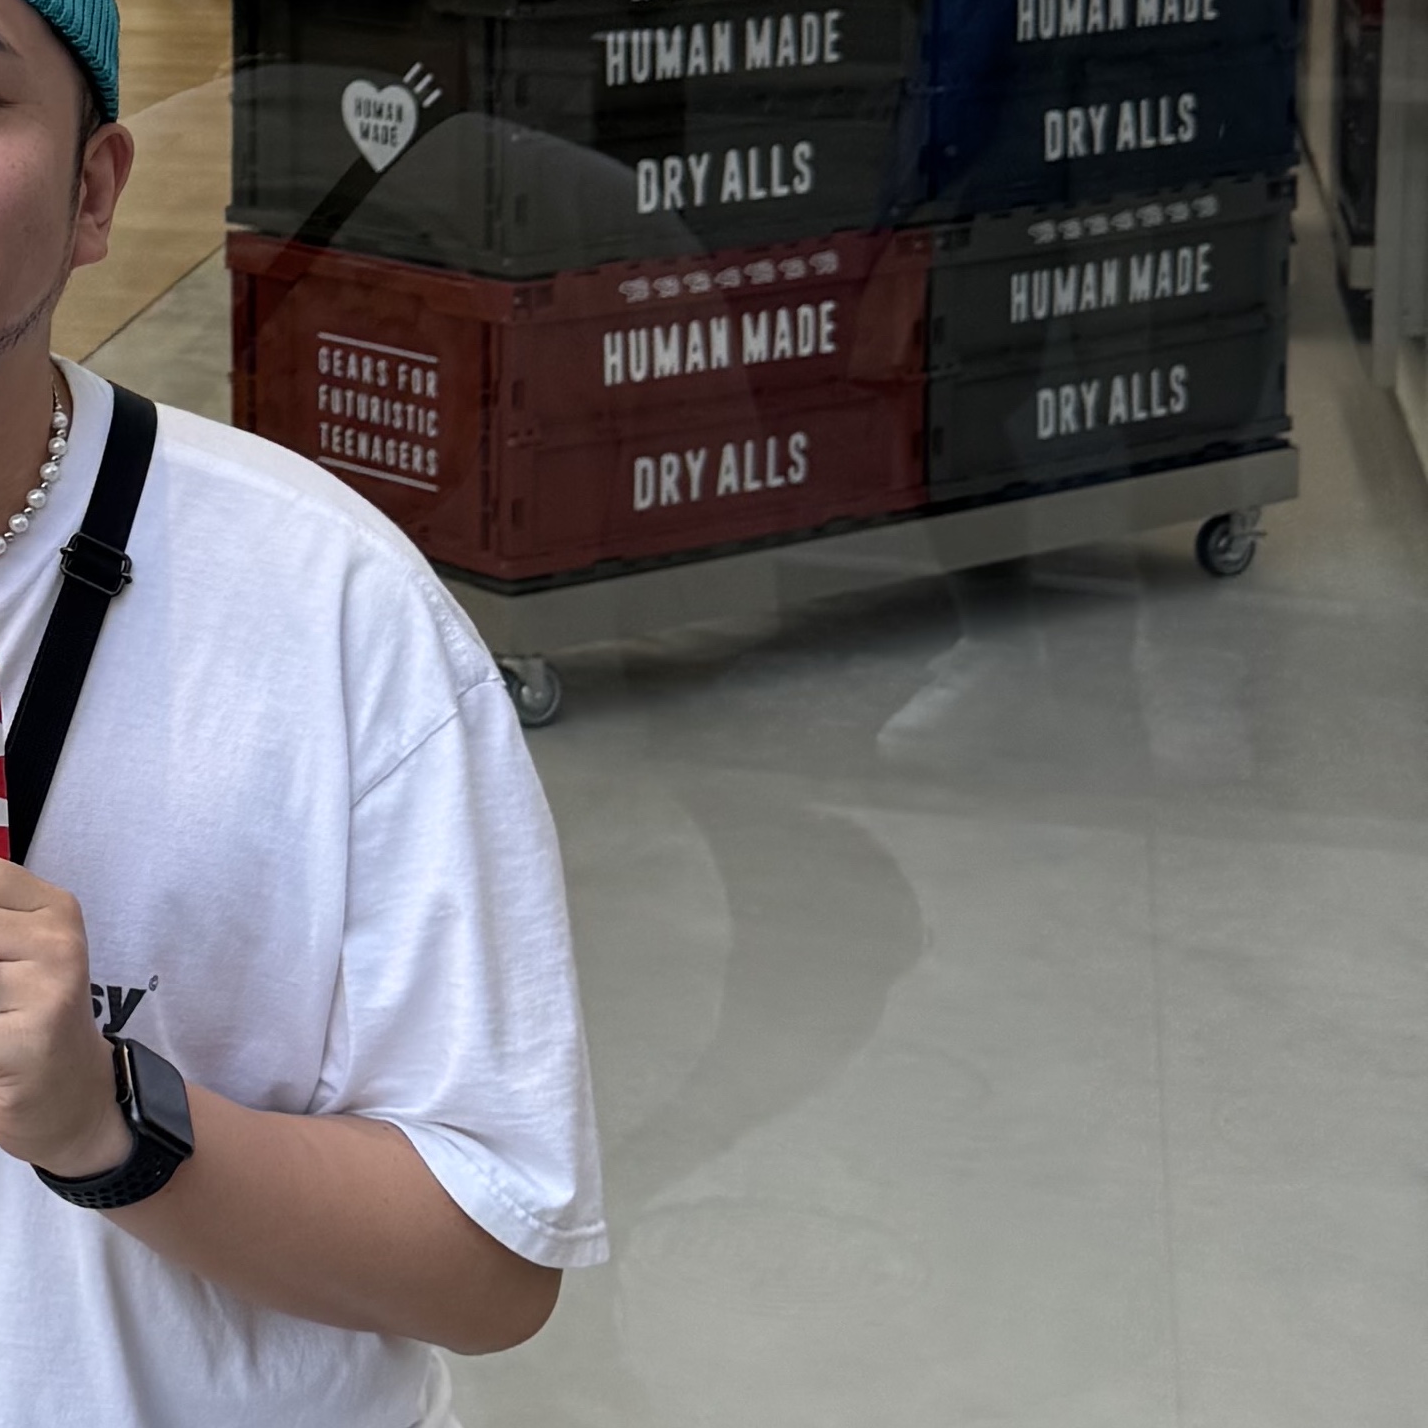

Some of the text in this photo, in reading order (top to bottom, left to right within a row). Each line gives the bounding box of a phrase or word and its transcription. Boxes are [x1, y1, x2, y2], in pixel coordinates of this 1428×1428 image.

[606, 9, 843, 86] HUMAN MADE
[354, 97, 403, 123] HUMAN
[359, 120, 398, 148] MADE
[1045, 93, 1196, 162] DRY ALLS
[637, 140, 813, 213] DRY ALLS
[1011, 243, 1213, 323] HUMAN MADE
[318, 346, 438, 399] GEARS FOR
[604, 300, 837, 387] HUMAN MADE
[318, 383, 439, 438] FUTURISTIC
[1037, 364, 1188, 440] DRY ALLS
[319, 421, 439, 477] TEENAGERS
[633, 431, 808, 511] DRY ALLS
